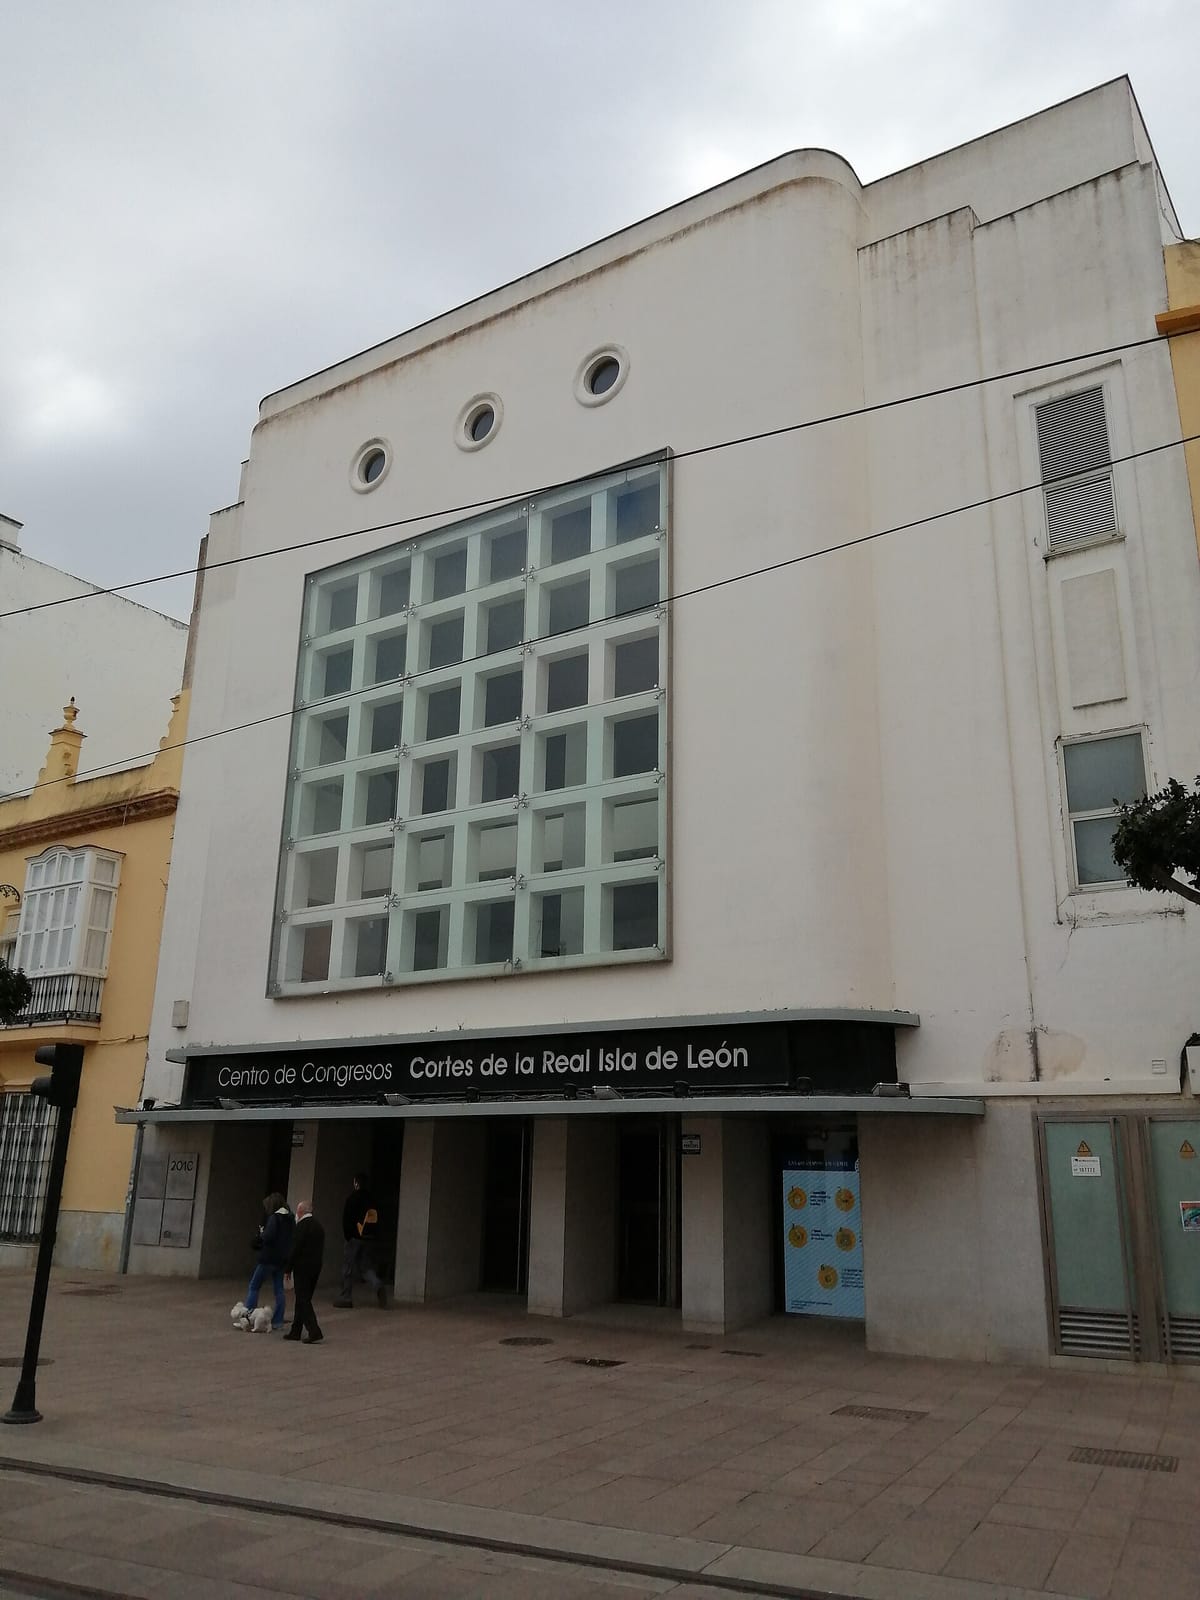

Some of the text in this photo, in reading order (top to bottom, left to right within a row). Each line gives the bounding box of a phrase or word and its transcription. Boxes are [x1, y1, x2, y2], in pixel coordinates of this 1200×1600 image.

[218, 1062, 393, 1087] Centro de Congresos
[409, 1040, 749, 1079] Cortes de la Real Isla de León
